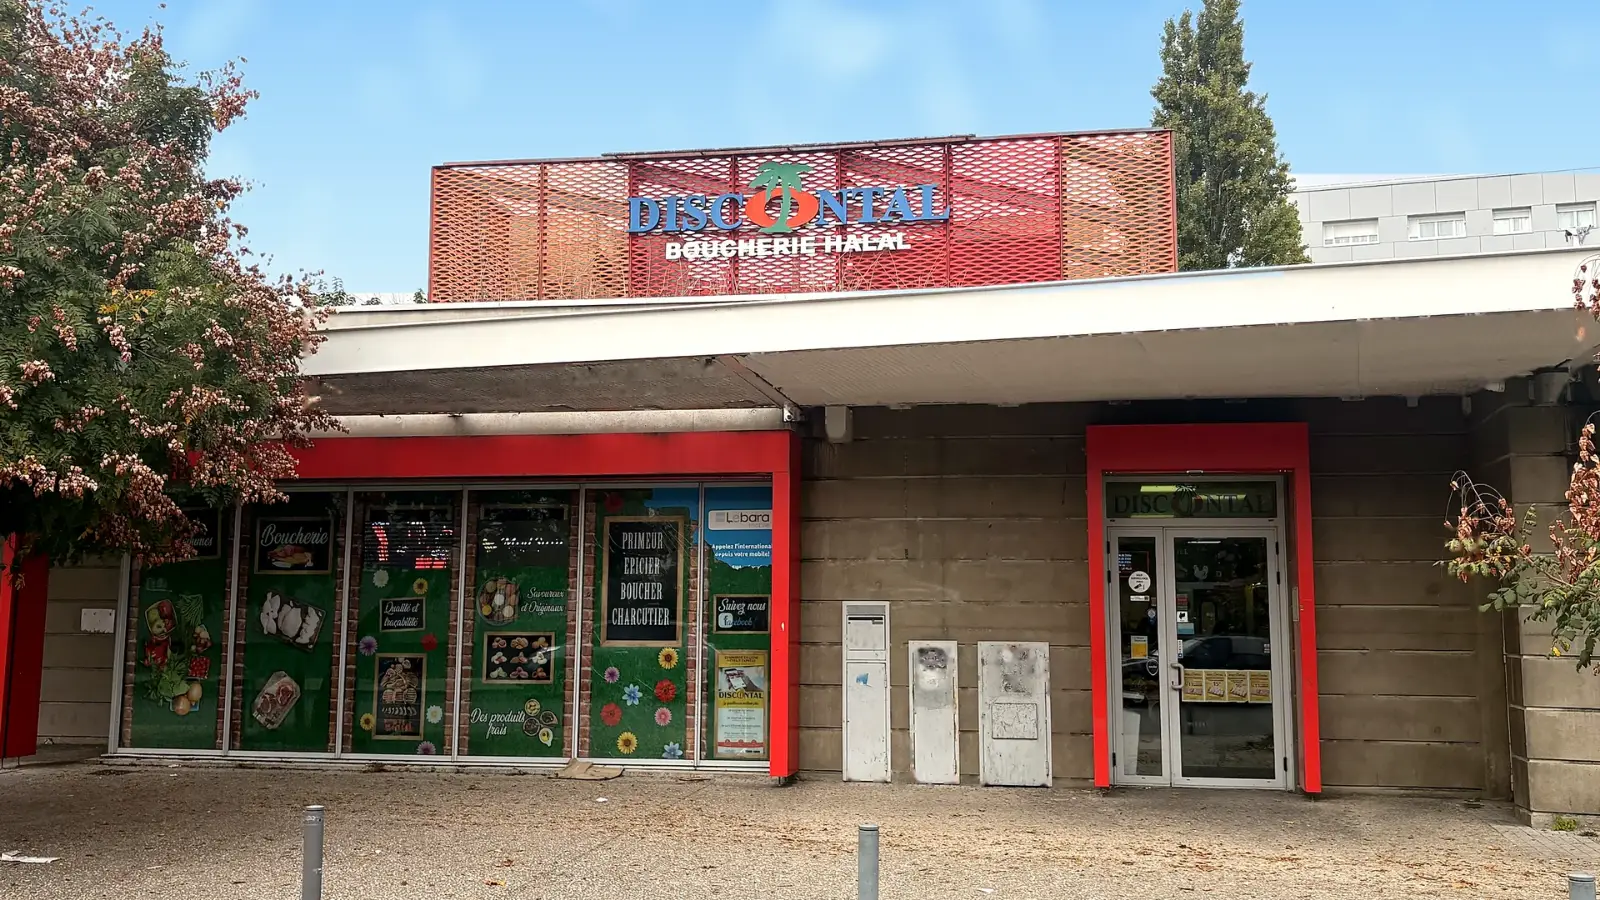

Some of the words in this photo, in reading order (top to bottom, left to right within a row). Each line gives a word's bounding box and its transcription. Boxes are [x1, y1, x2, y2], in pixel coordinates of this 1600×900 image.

[627, 183, 950, 233] DISCONTAL
[665, 237, 816, 261] BOUCHERIE
[823, 232, 912, 254] HALAL
[1115, 494, 1272, 516] DISCONTAL
[726, 512, 770, 523] Lebara
[260, 523, 329, 547] Boucherie
[621, 531, 664, 550] PRIMEUR
[734, 542, 772, 550] l'internationa
[623, 556, 661, 575] EPICIER
[620, 582, 663, 601] BOUCHER
[528, 600, 565, 615] Originaux
[718, 598, 745, 615] Suivez
[747, 602, 766, 611] nous
[611, 607, 670, 627] CHARCUTIER
[719, 691, 763, 699] DISCONTAL
[471, 708, 489, 724] Des
[490, 709, 526, 726] produits
[486, 723, 507, 739] frais
